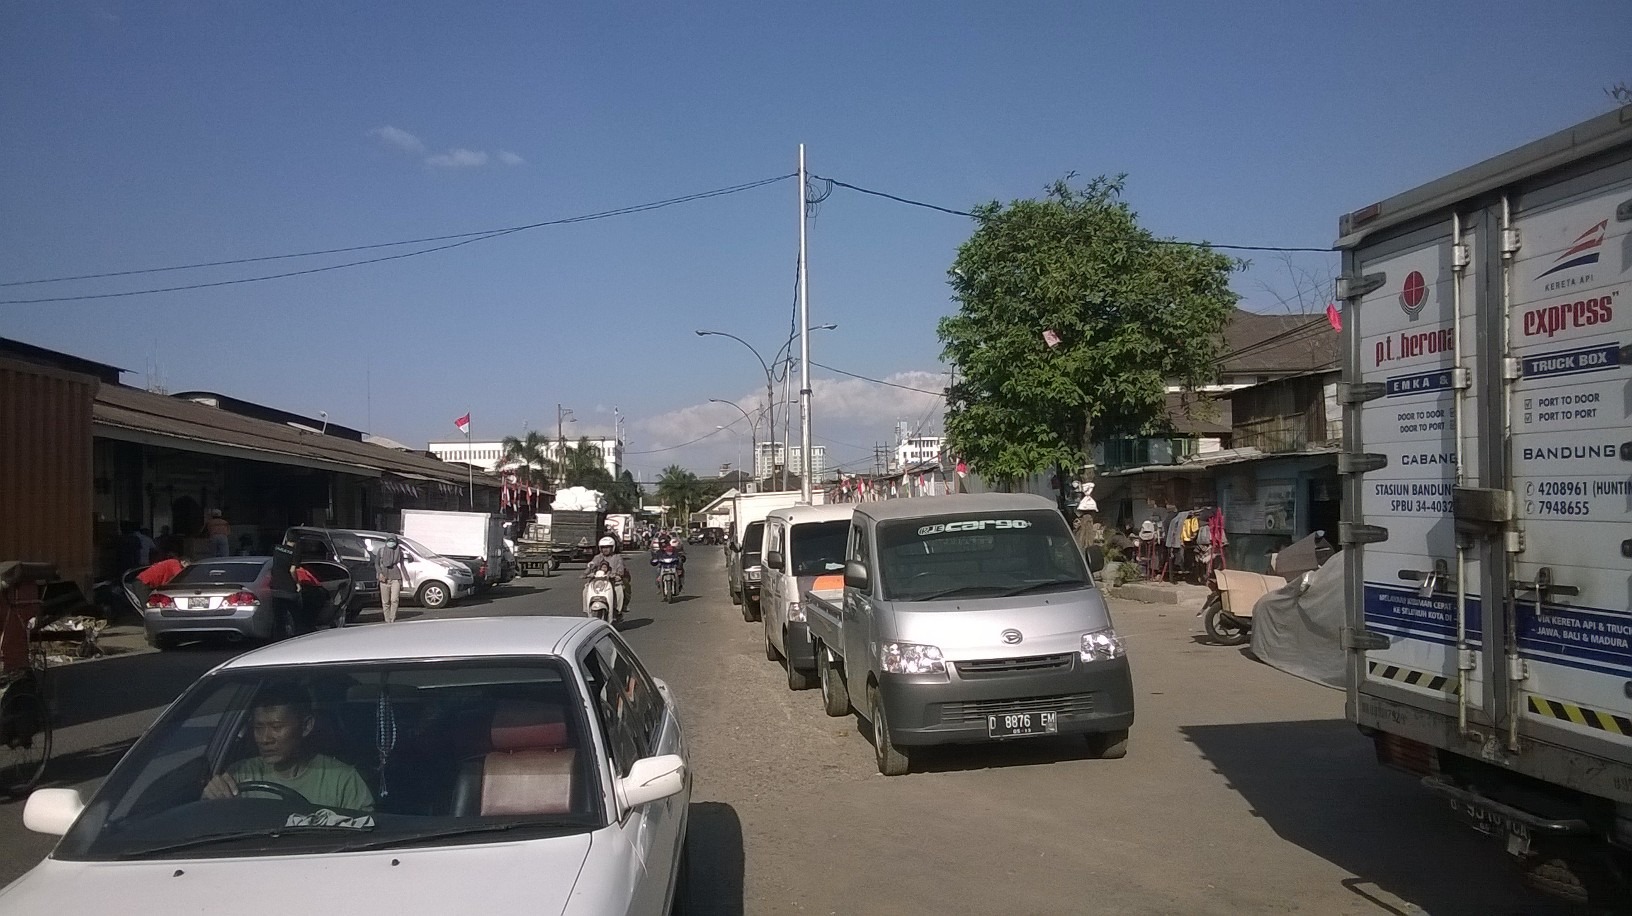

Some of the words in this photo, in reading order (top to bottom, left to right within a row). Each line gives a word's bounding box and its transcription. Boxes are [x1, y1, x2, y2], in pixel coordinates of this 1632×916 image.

[1545, 278, 1576, 291] KERETA
[1580, 274, 1594, 284] API
[1532, 356, 1575, 373] TRUCK
[1579, 351, 1608, 366] BOX
[1393, 377, 1430, 392] EMKA
[1440, 375, 1449, 385] &
[1538, 397, 1559, 408] PORT
[1561, 395, 1573, 405] TO
[1574, 393, 1600, 404] DOOR
[1397, 412, 1415, 421] DOOR
[1416, 411, 1425, 420] TO
[1426, 409, 1445, 419] DOOR
[1538, 411, 1559, 422] PORT
[1561, 410, 1573, 420] TO
[1574, 408, 1597, 419] PORT
[1400, 424, 1418, 433] DOOR
[1419, 423, 1428, 432] TO
[1428, 421, 1445, 431] PORT
[1523, 445, 1616, 460] BANDUNG
[1375, 484, 1409, 496] STASIUN
[1411, 484, 1455, 496] BANDUN
[1538, 481, 1588, 496] 4208961
[1391, 500, 1413, 512] SPBU
[1538, 501, 1590, 516] 7948655
[945, 519, 1028, 533] cargo
[1392, 606, 1401, 614] KE
[1427, 611, 1445, 620] KOTA
[1433, 601, 1453, 611] CEPAT
[1537, 615, 1551, 624] VIA
[1552, 616, 1581, 628] KERETA
[1582, 620, 1597, 630] API
[1597, 622, 1605, 632] &
[1562, 630, 1581, 641] BALI
[1582, 633, 1589, 643] &
[1590, 634, 1629, 649] MADURA
[989, 716, 997, 730] D
[1004, 714, 1031, 729] 8876
[1040, 713, 1055, 726] EM
